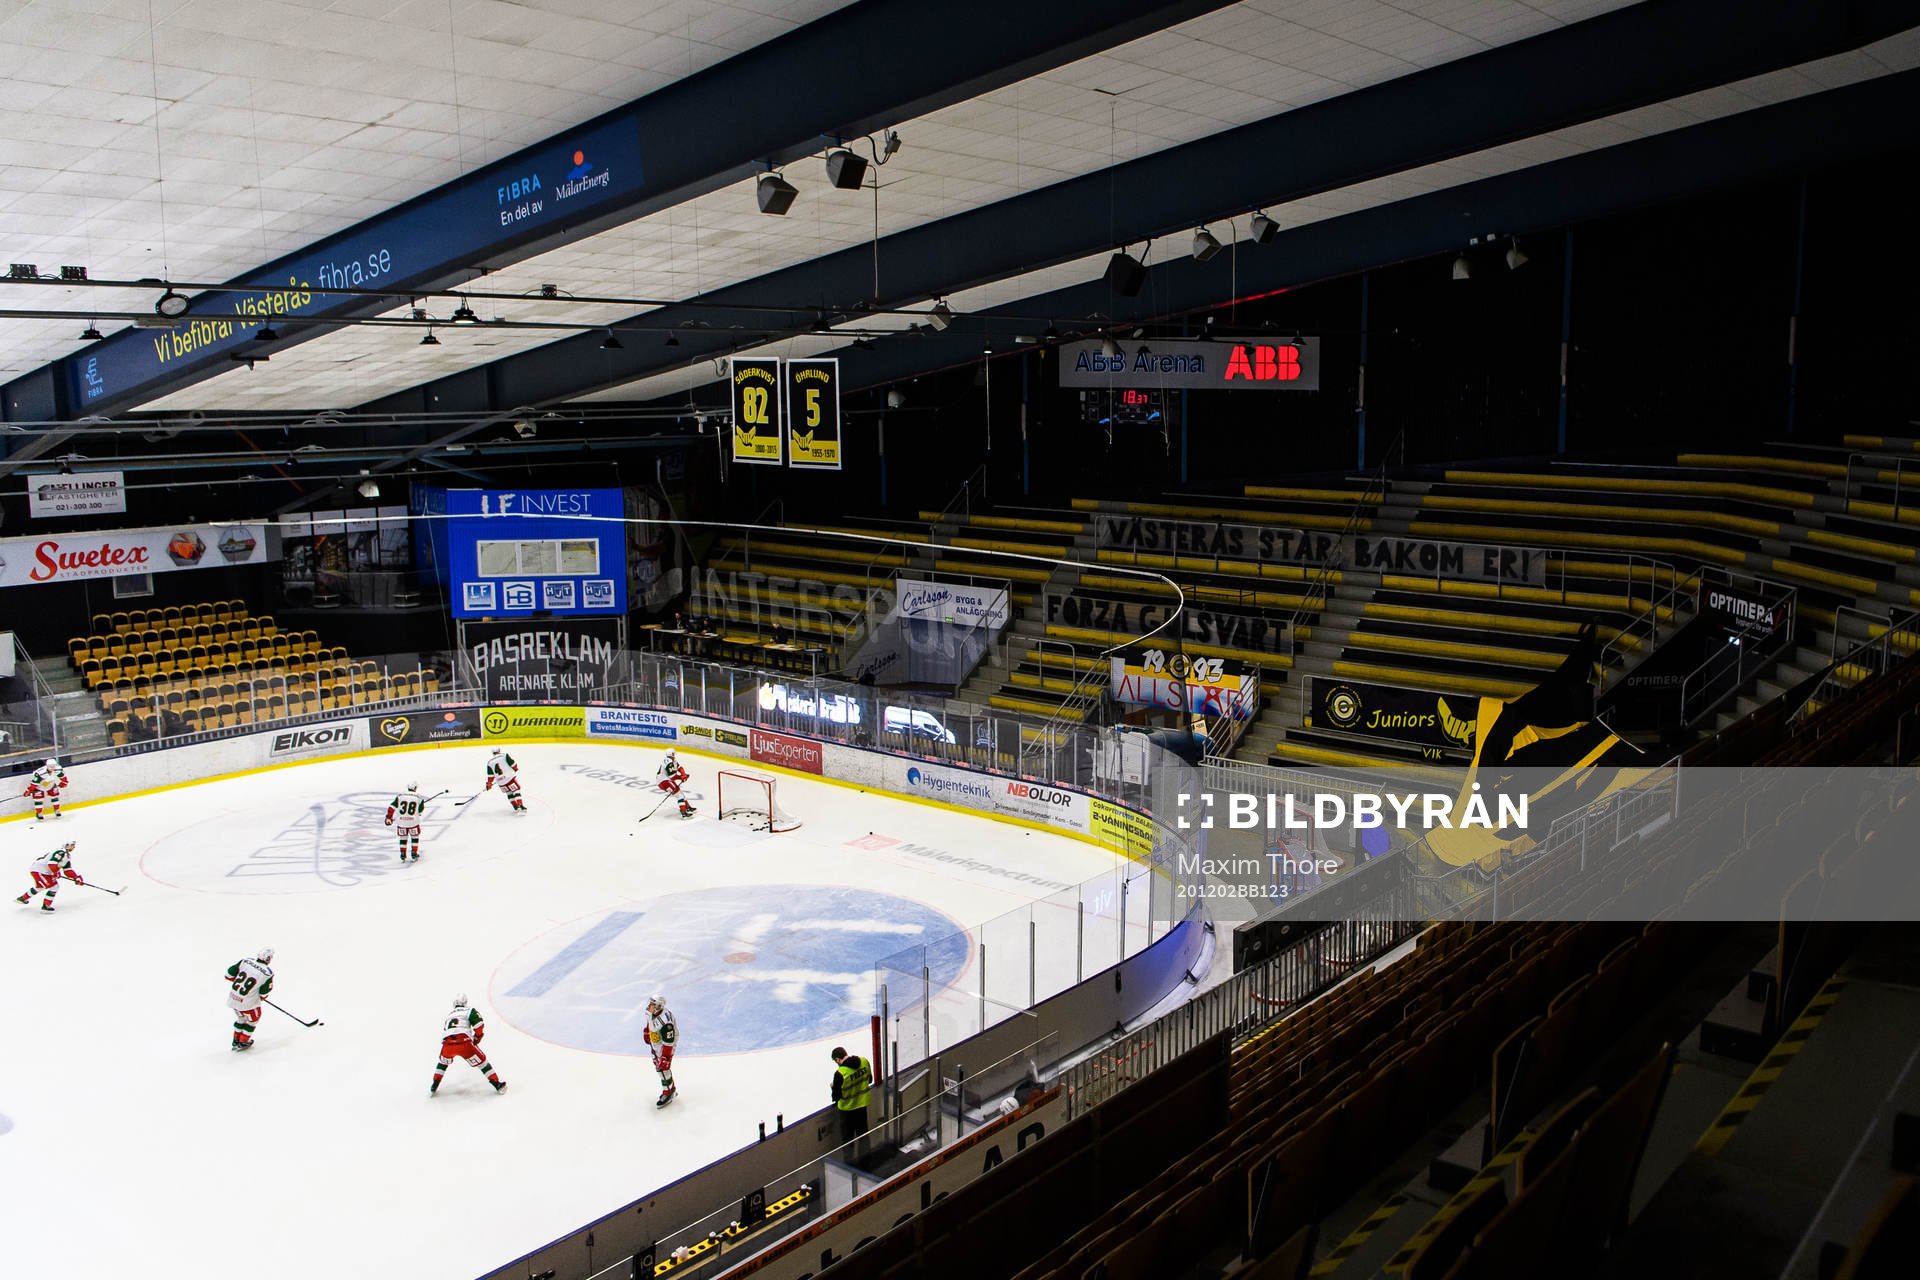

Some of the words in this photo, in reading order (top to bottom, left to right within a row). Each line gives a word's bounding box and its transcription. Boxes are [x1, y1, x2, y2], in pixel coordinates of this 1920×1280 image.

[498, 174, 541, 204] FIBRA
[555, 168, 609, 201] MälarEnergi
[501, 210, 514, 226] En
[515, 202, 530, 221] del
[532, 200, 543, 214] av
[154, 336, 170, 363] Vi
[318, 249, 391, 297] fibra.se
[1075, 352, 1126, 373] ABB
[1133, 353, 1204, 373] Arena
[1224, 345, 1301, 381] ABB
[743, 387, 769, 424] 82
[806, 388, 820, 427] 5
[521, 494, 592, 513] INVEST
[29, 541, 149, 581] Swetex
[1355, 538, 1463, 574] BAKOM
[1483, 548, 1530, 582] ER!
[902, 589, 952, 613] Carlsson
[955, 596, 976, 605] BYGG
[1047, 595, 1127, 632] FORZA
[1710, 591, 1774, 625] OPTIMERA
[473, 630, 612, 674] BASREKLAM
[1142, 649, 1165, 673] 19
[512, 718, 583, 727] WARRIOR
[600, 711, 668, 724] BRANTESTIG
[1366, 709, 1436, 728] Juniors
[662, 728, 673, 736] AB
[753, 733, 819, 763] LjusExperten
[1422, 747, 1442, 759] VIK
[922, 773, 992, 799] Hygienteknik
[399, 800, 417, 816] 38
[232, 971, 257, 996] 29
[850, 1067, 867, 1082] PRESS
